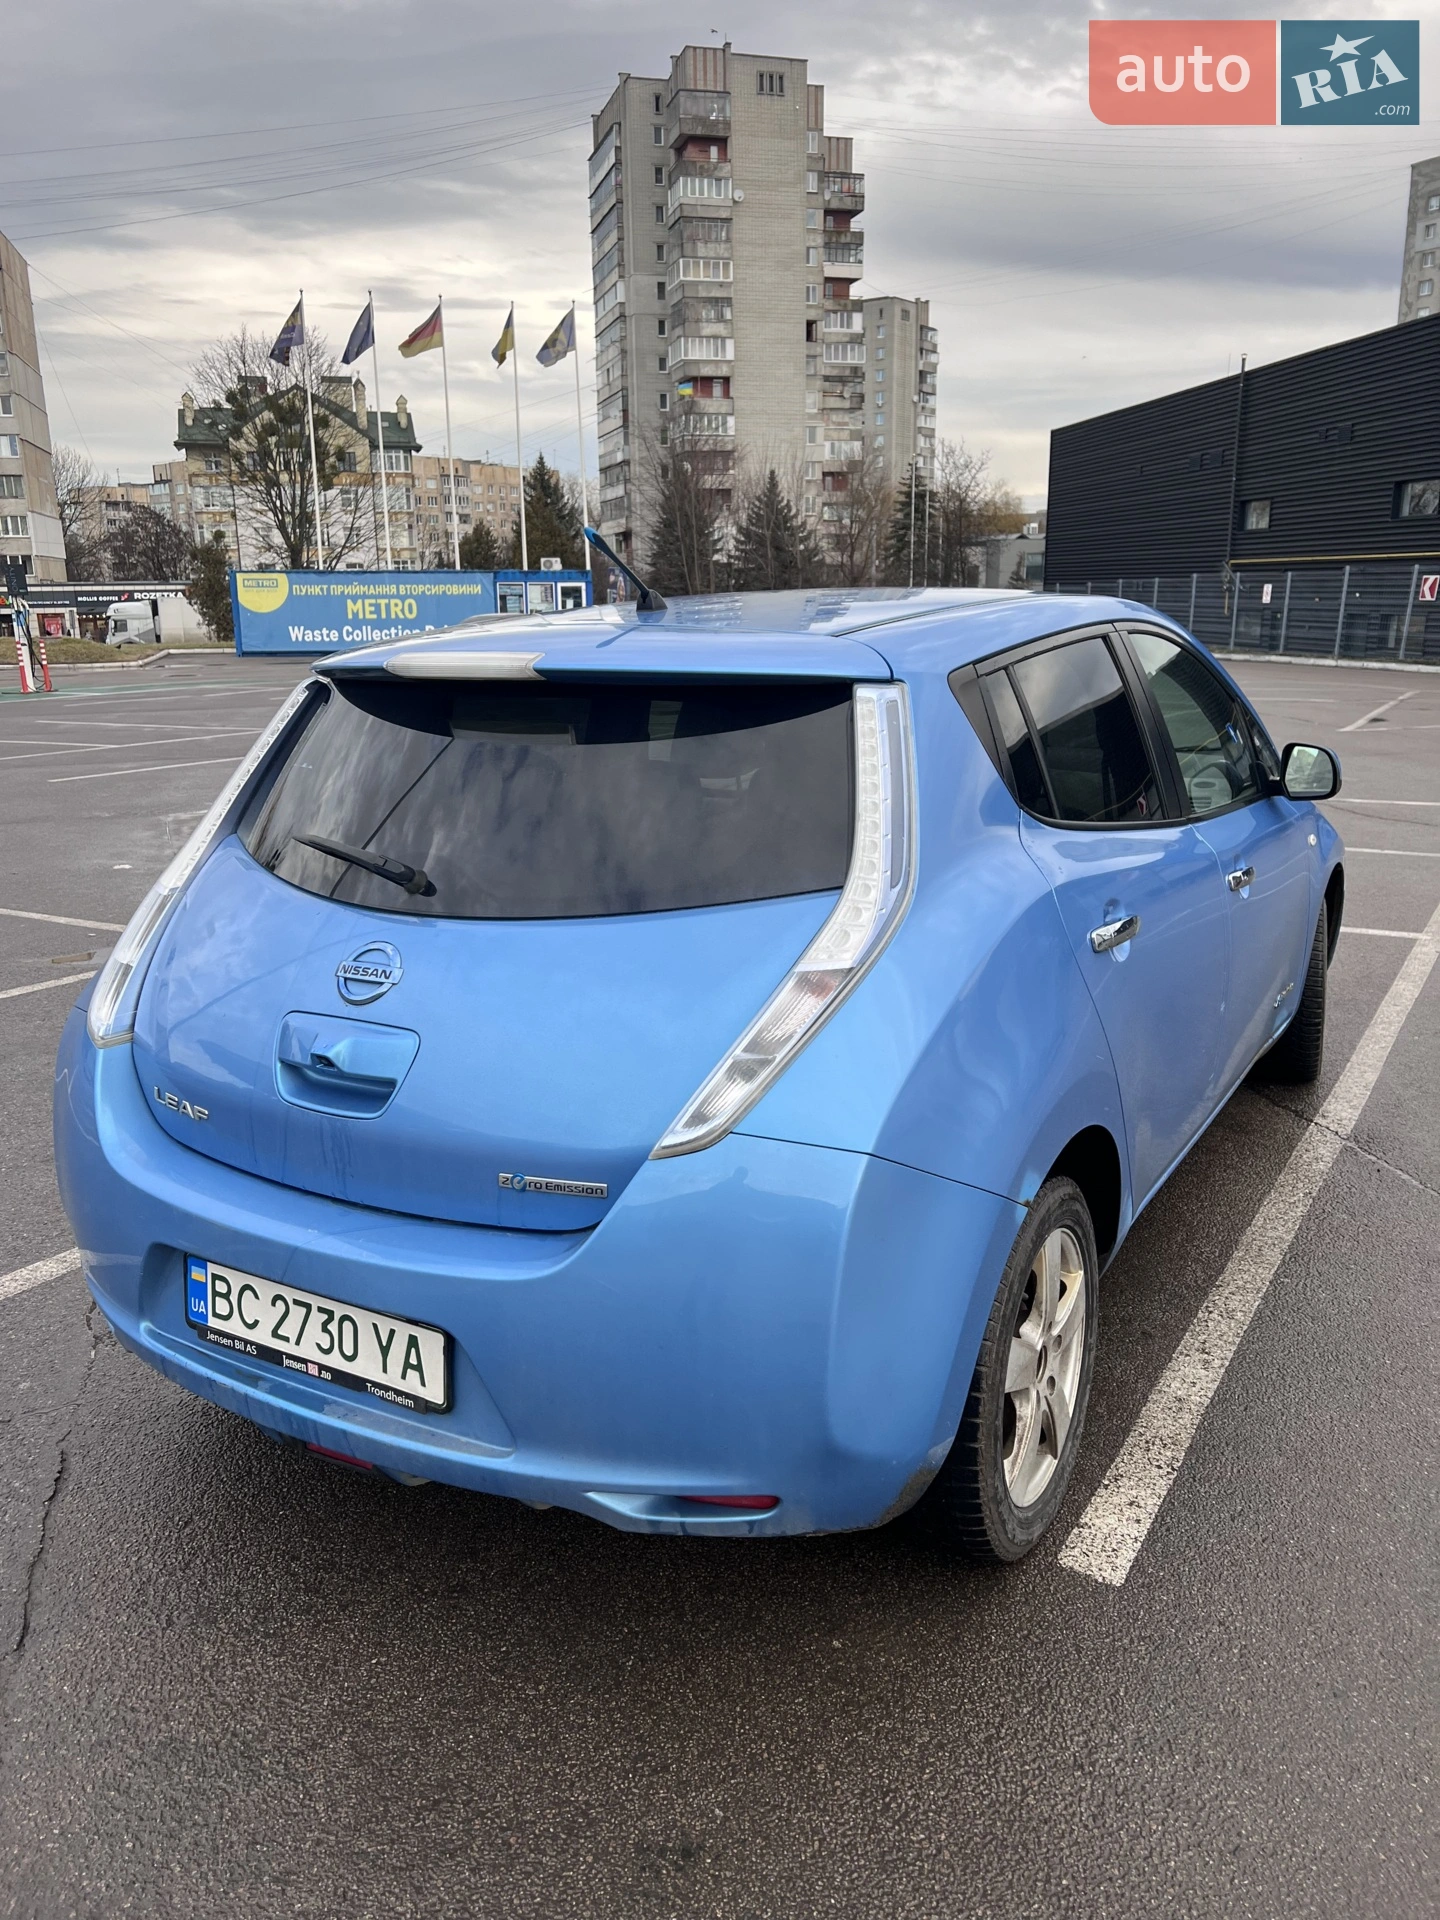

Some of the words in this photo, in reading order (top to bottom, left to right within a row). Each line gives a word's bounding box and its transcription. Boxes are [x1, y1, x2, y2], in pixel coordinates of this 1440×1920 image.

[244, 579, 277, 588] METRO
[292, 584, 328, 596] ПУНКТ
[330, 582, 397, 596] ПРИЙМАННЯ
[399, 584, 482, 596] ВТОРСИРОВИНИ
[133, 591, 184, 600] ROZETKA
[346, 598, 418, 620] METRO
[288, 625, 339, 642] Waste
[339, 963, 393, 981] NISSAN
[154, 1085, 209, 1121] LEAF
[545, 1182, 604, 1196] Emission
[191, 1297, 207, 1316] UA
[210, 1271, 261, 1331] BC
[270, 1293, 359, 1363] 2730
[371, 1321, 427, 1388] YA
[206, 1330, 234, 1348] Jensen
[234, 1339, 245, 1351] Bil
[245, 1343, 257, 1355] AS
[282, 1354, 307, 1372] Jensen
[365, 1382, 415, 1409] Trondheim
